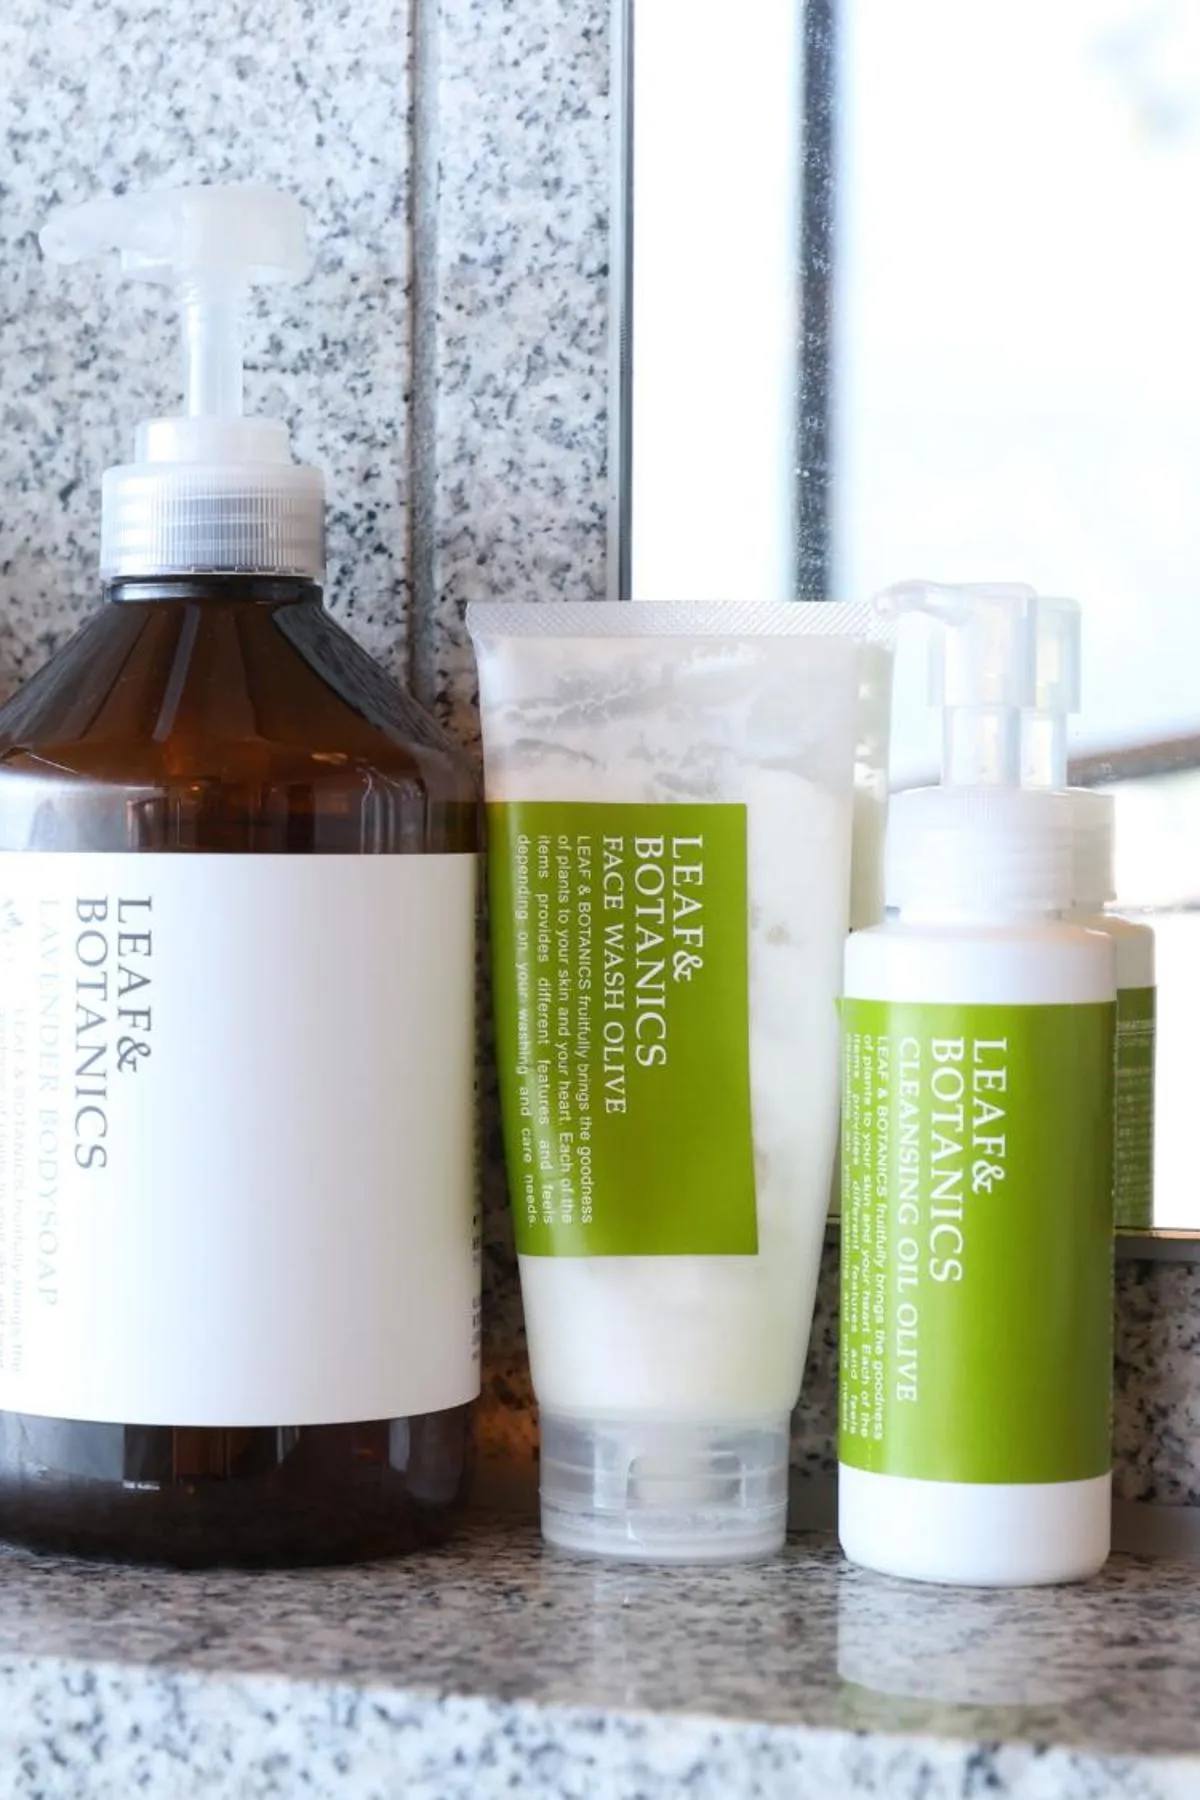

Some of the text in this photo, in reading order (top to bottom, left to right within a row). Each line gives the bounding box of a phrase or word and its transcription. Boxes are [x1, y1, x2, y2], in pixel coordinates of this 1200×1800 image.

[557, 835, 572, 852] of
[515, 835, 532, 920] depending
[555, 856, 572, 904] plants
[557, 909, 572, 925] to
[672, 835, 704, 984] LEAF&
[517, 932, 530, 951] on
[555, 929, 570, 965] your
[635, 835, 667, 1067] BOTANICS
[117, 896, 152, 1073] LEAF&
[515, 963, 531, 1003] your
[557, 969, 573, 1002] skin
[603, 836, 627, 1115] FACE WASH OLIVE
[74, 895, 108, 1169] BOTANICS
[514, 1008, 532, 1075] washing
[534, 835, 556, 1224] items provides different features and feels
[557, 1006, 572, 1037] and
[574, 835, 595, 1225] LEAF & BOTANICS fruitfully brings the goodness
[554, 1042, 570, 1076] your
[37, 898, 60, 1306] LAVENDER BODYSOAP
[518, 1086, 534, 1117] and
[971, 1037, 1007, 1194] LEAF&
[520, 1127, 534, 1163] care
[558, 1132, 574, 1172] Each
[929, 1036, 965, 1283] BOTANICS
[560, 1178, 575, 1195] of
[560, 1197, 576, 1225] the
[871, 1036, 890, 1441] LEAF & BOTANICS fruitfully brings the goodness
[896, 1036, 921, 1402] CLEANSING OIL OLIVE
